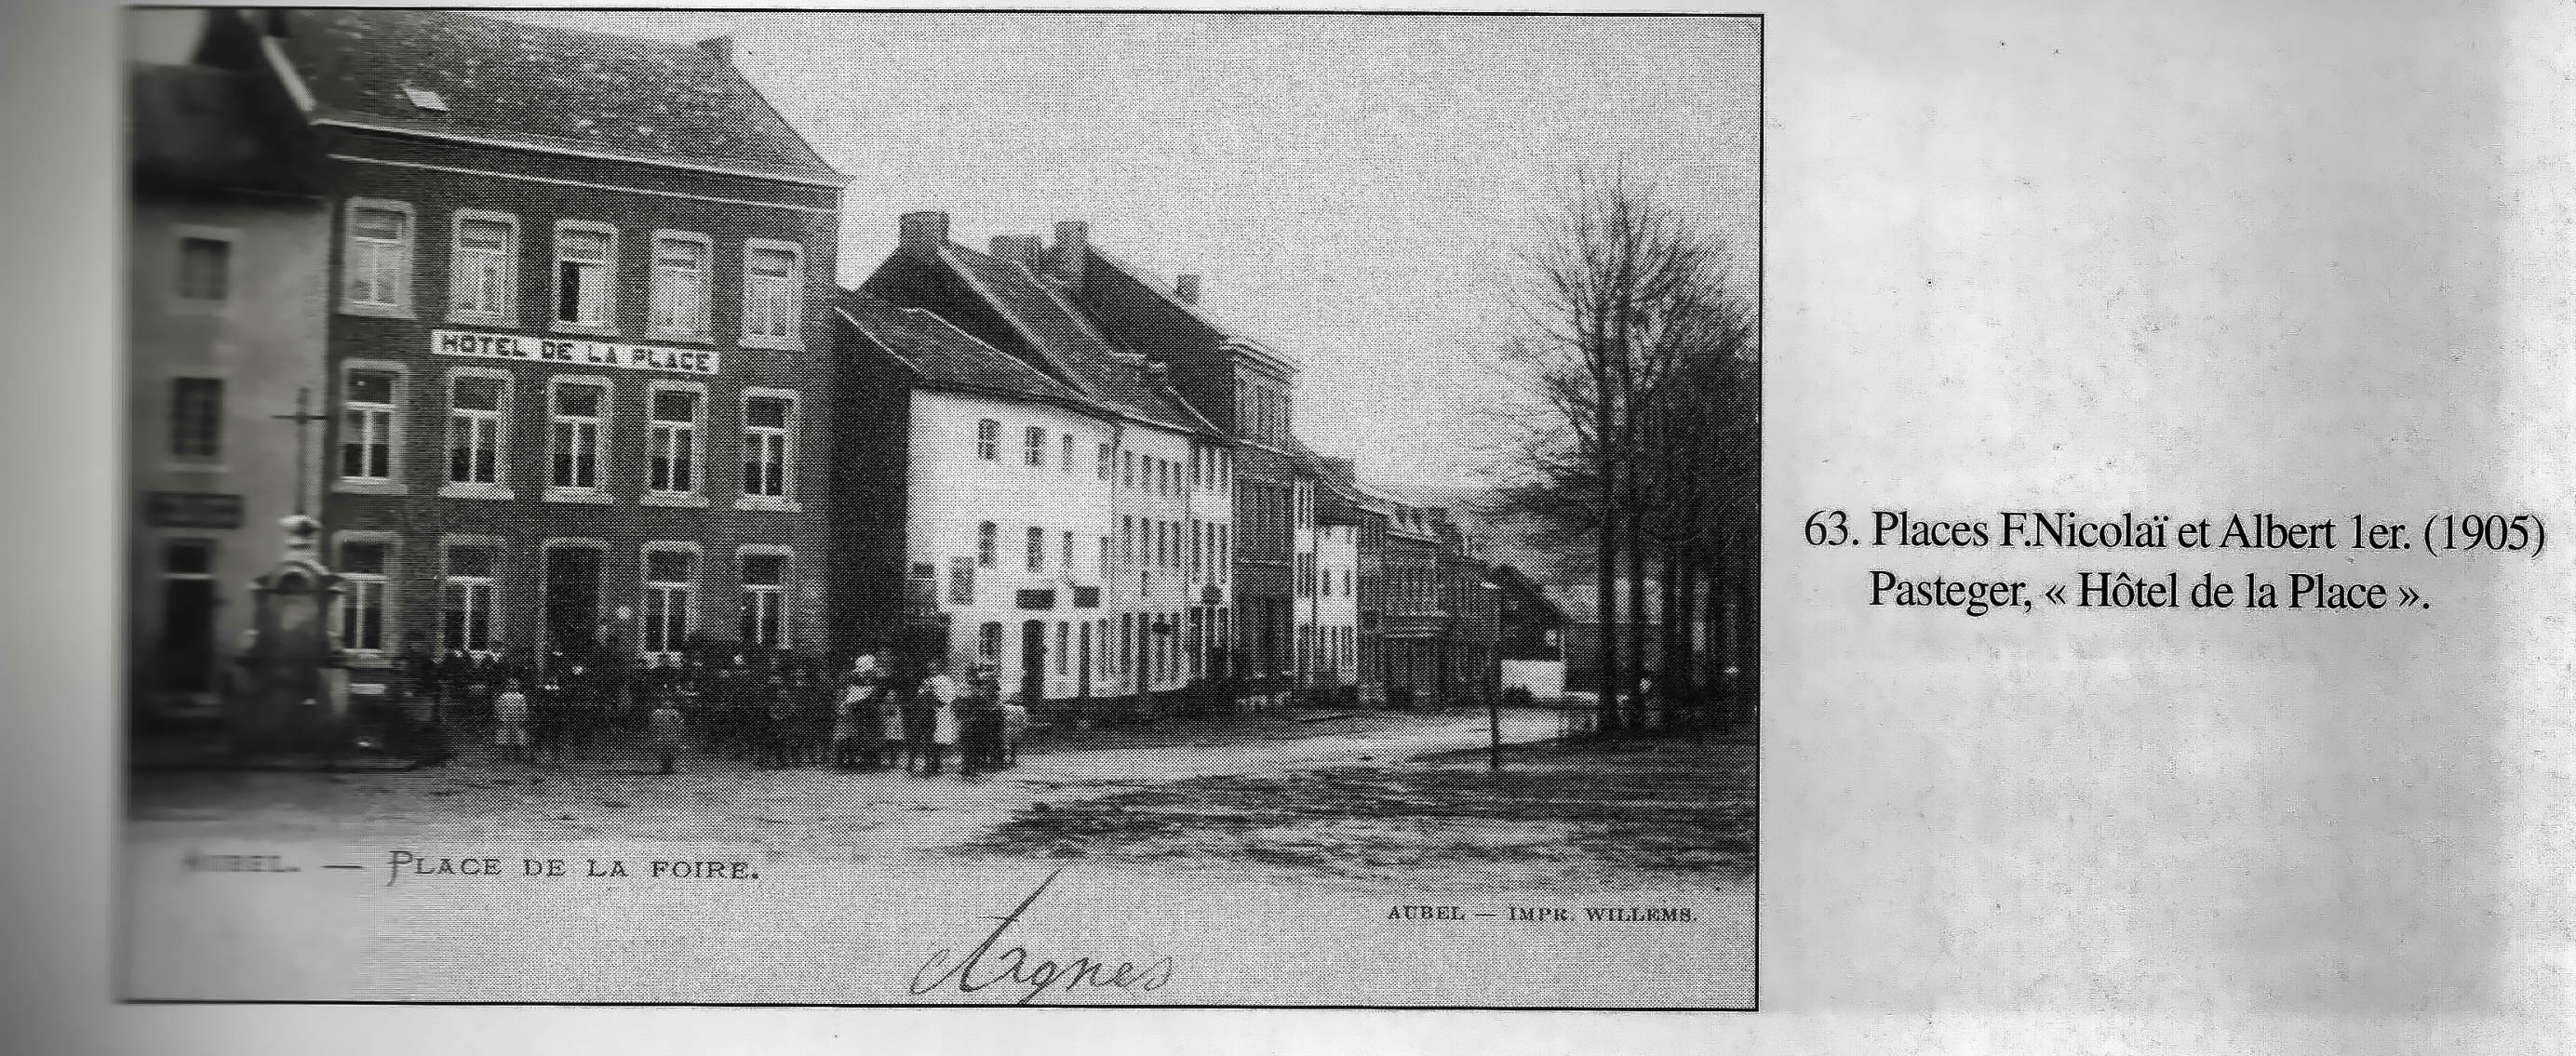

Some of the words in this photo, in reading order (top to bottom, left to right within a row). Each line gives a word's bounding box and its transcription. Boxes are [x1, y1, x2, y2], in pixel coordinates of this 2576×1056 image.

[441, 334, 528, 357] HOTEL
[541, 341, 573, 361] DE
[587, 344, 618, 364] LA
[631, 348, 709, 371] PLACE
[1805, 510, 1859, 546] 63.
[1872, 510, 1989, 547] Places
[1999, 512, 2169, 548] F.Nicolaï
[2178, 518, 2212, 549] et
[2218, 513, 2338, 550] Albert
[2351, 514, 2410, 550] 1er.
[2424, 514, 2545, 558] (1905)
[1869, 570, 2032, 618] Pasteger,
[2077, 571, 2180, 608] Hôtel
[2191, 572, 2234, 608] de
[2245, 572, 2279, 609] la
[2288, 572, 2387, 609] Place
[1387, 904, 1466, 921] AUBEL
[1585, 906, 1697, 923] WILLEMS.
